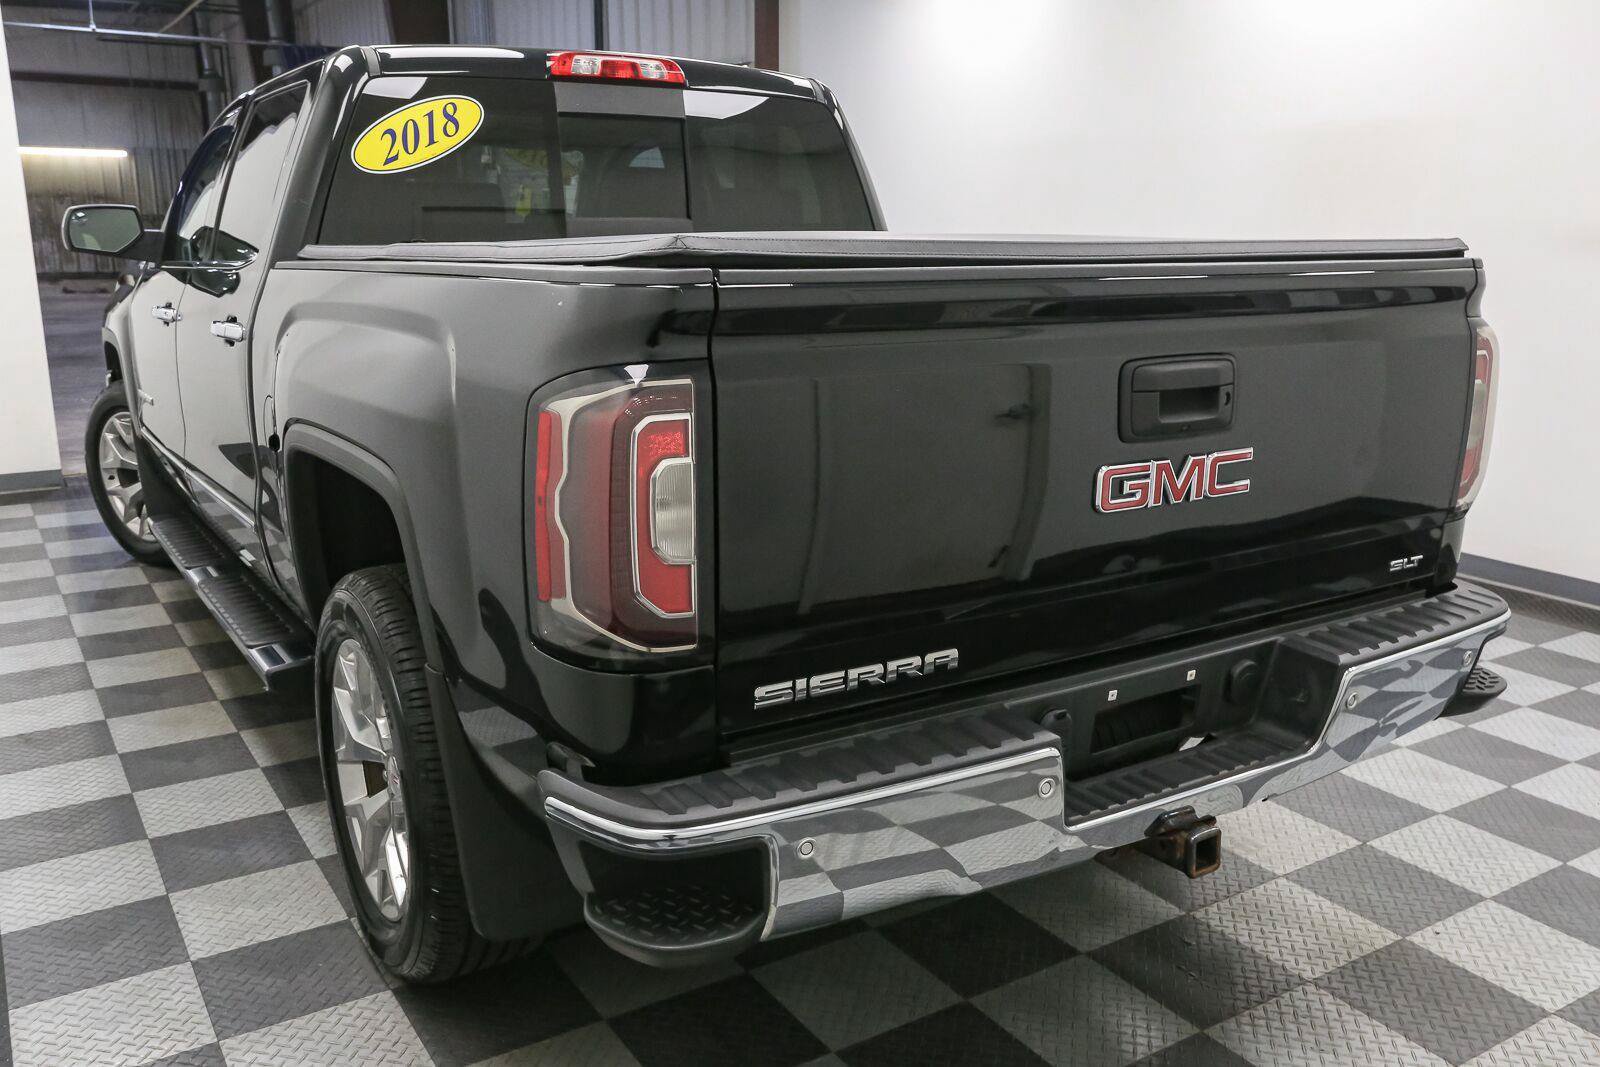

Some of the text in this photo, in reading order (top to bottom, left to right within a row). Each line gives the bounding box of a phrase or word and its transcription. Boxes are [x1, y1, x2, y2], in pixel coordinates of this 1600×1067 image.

[380, 101, 460, 167] 2018
[1095, 446, 1254, 513] GMC
[1389, 554, 1424, 572] SLT
[754, 647, 960, 711] SIERRA
